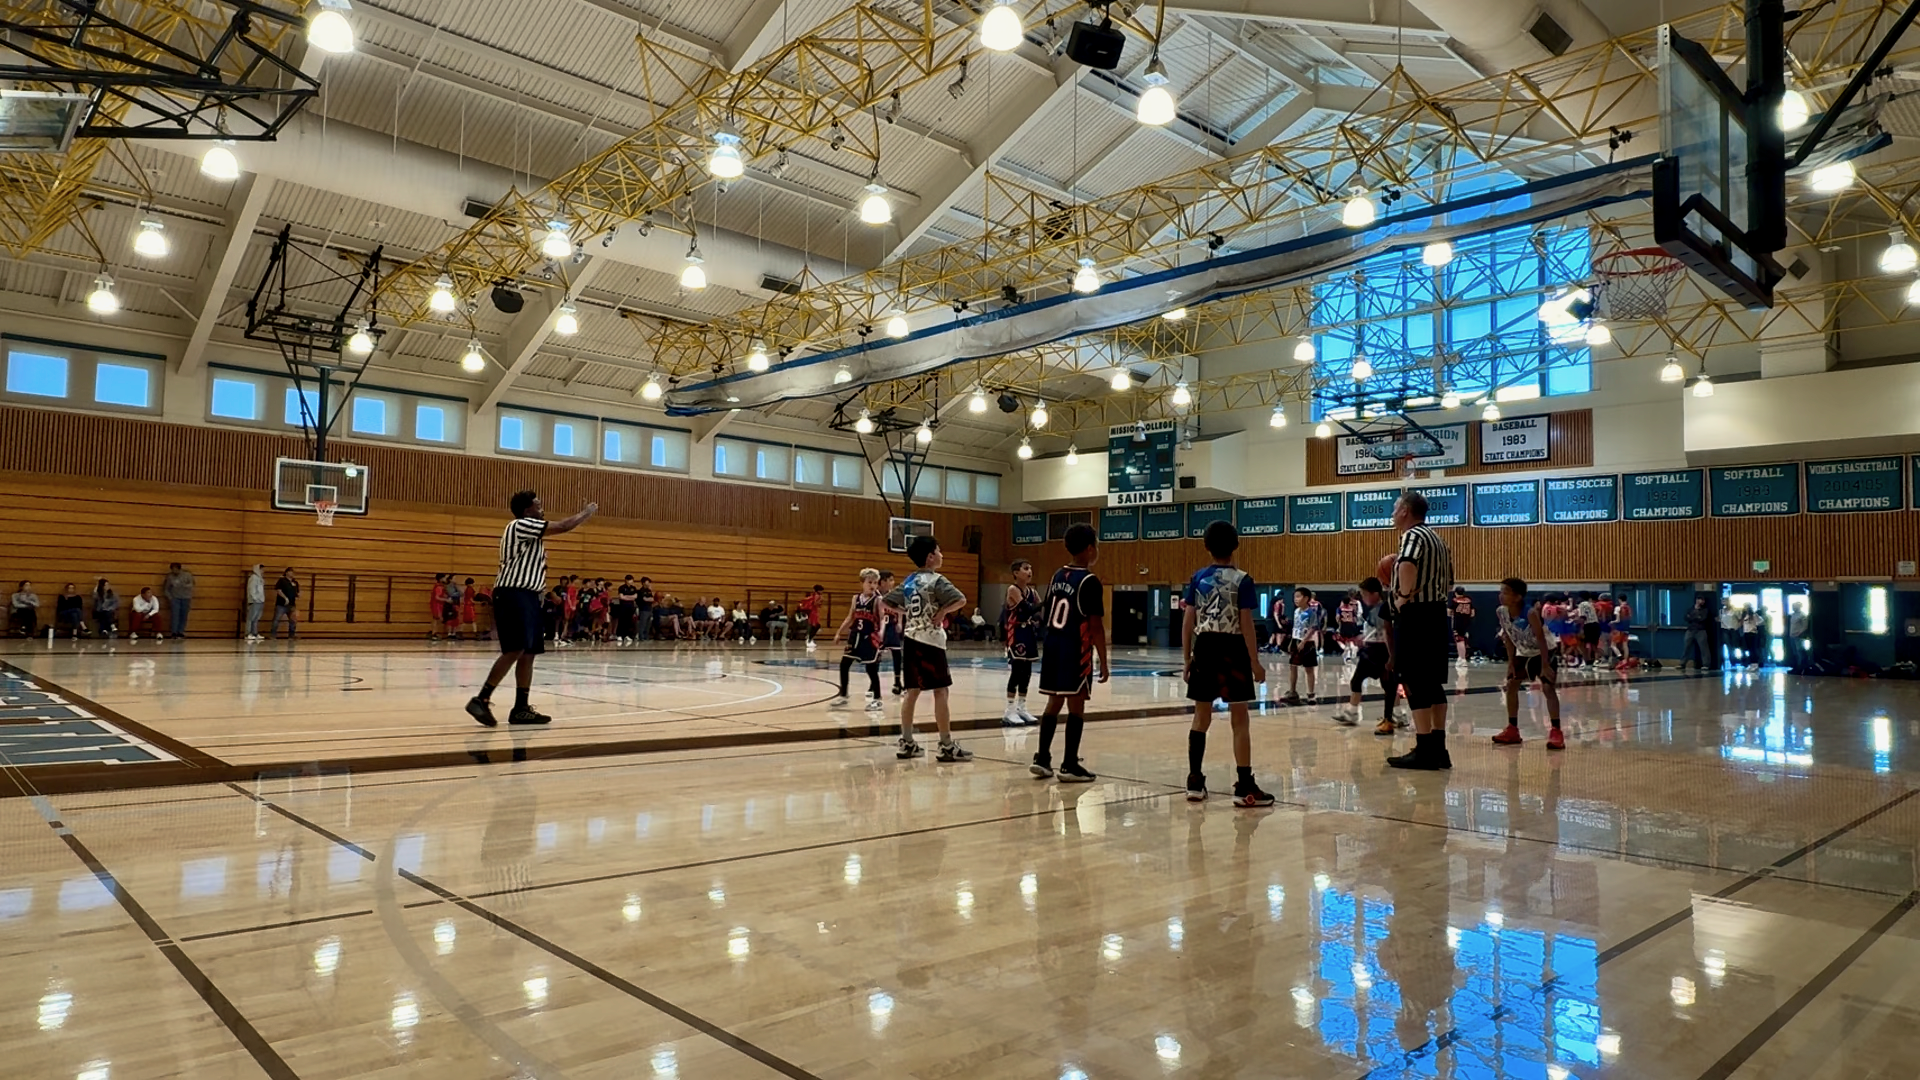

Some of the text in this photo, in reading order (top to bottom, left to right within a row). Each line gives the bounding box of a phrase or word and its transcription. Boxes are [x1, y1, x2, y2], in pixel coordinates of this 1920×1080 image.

[1144, 421, 1172, 431] OLLEGE
[1492, 419, 1537, 432] BASEBALL
[1502, 434, 1526, 446] 1983
[1485, 448, 1545, 461] STATE CHAMPIONS
[1340, 461, 1390, 473] STATE CHAMPIONS
[1809, 460, 1899, 475] WOMEN'S BASKETBALL
[1723, 467, 1784, 480] SOFTBALL
[1548, 478, 1613, 490] MEN'S SOCCER
[1635, 474, 1690, 485] SOFTBALL
[1477, 483, 1535, 494] MEN'S SOCCER
[1118, 491, 1162, 504] SAINTS
[1297, 495, 1333, 505] BASEBALL
[1354, 492, 1392, 502] BASEBALL
[1194, 502, 1226, 512] BASEBALL
[1243, 499, 1277, 509] BASEBALL
[1721, 501, 1788, 514] CHAMPIONS
[1818, 496, 1890, 510] CHAMPIONS
[1362, 505, 1384, 515] 2016
[1554, 509, 1609, 520] CHAMPIONS
[1633, 506, 1692, 518] CHAMPIONS
[1352, 517, 1395, 527] CHAMPIONS
[1424, 514, 1460, 524] AMPIONS
[1480, 513, 1531, 523] CHAMPIONS
[1242, 524, 1278, 534] CHAMPIONS
[1295, 522, 1335, 532] CHAMPIONS
[1146, 529, 1179, 538] CHAMPIONS
[1205, 594, 1221, 618] 4
[1047, 595, 1070, 629] 10
[857, 619, 864, 631] 3
